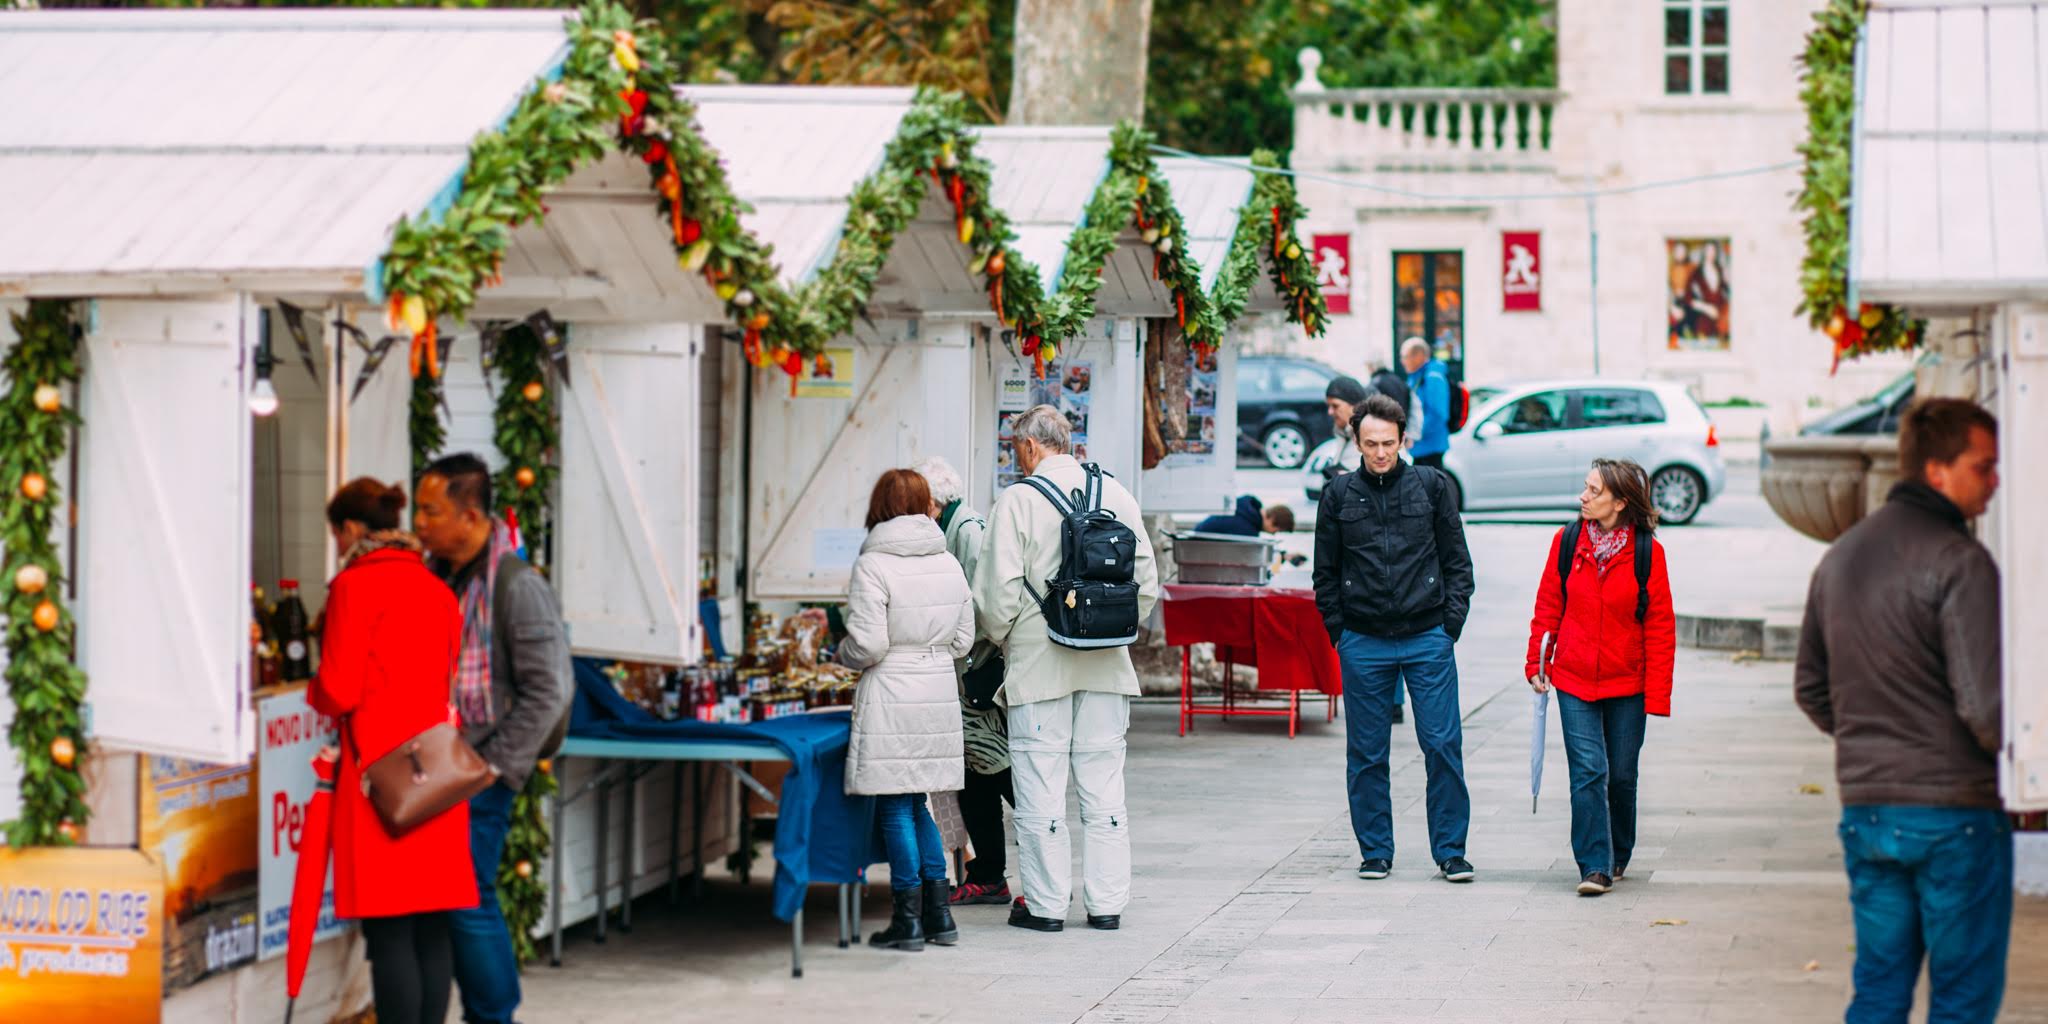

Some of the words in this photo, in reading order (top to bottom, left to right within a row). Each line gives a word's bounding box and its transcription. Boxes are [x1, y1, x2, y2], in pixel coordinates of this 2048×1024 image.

[266, 714, 300, 748] NOVO
[304, 711, 313, 741] U
[273, 789, 307, 859] Pe
[57, 890, 91, 932] OD
[98, 892, 148, 936] RIBE
[19, 943, 128, 977] products
